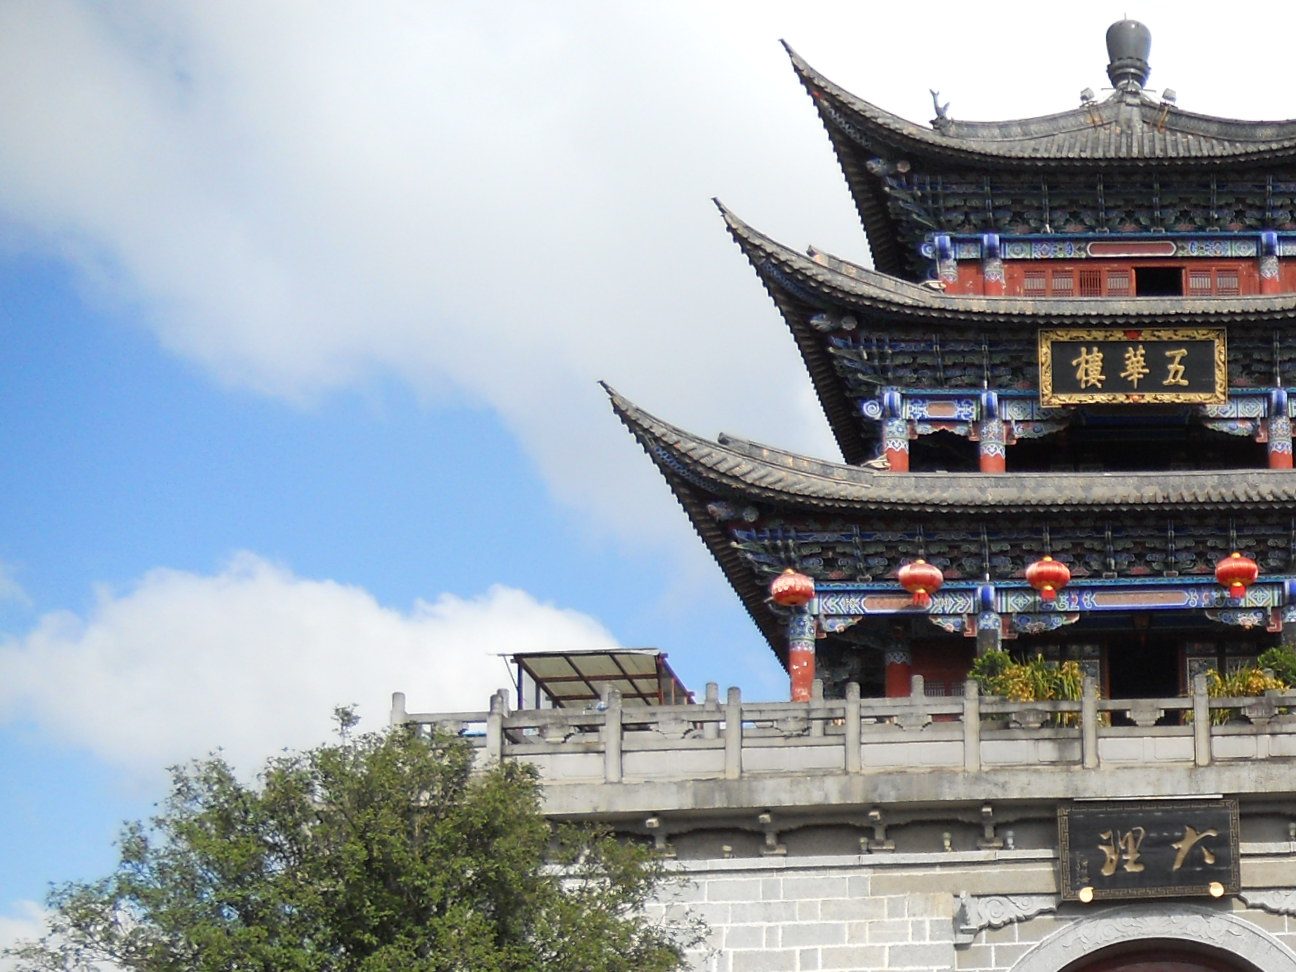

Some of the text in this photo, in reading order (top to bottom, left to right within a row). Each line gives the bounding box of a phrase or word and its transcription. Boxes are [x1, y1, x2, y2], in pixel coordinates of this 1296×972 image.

[1071, 344, 1189, 389] 五華樓
[1098, 825, 1219, 876] 大理
